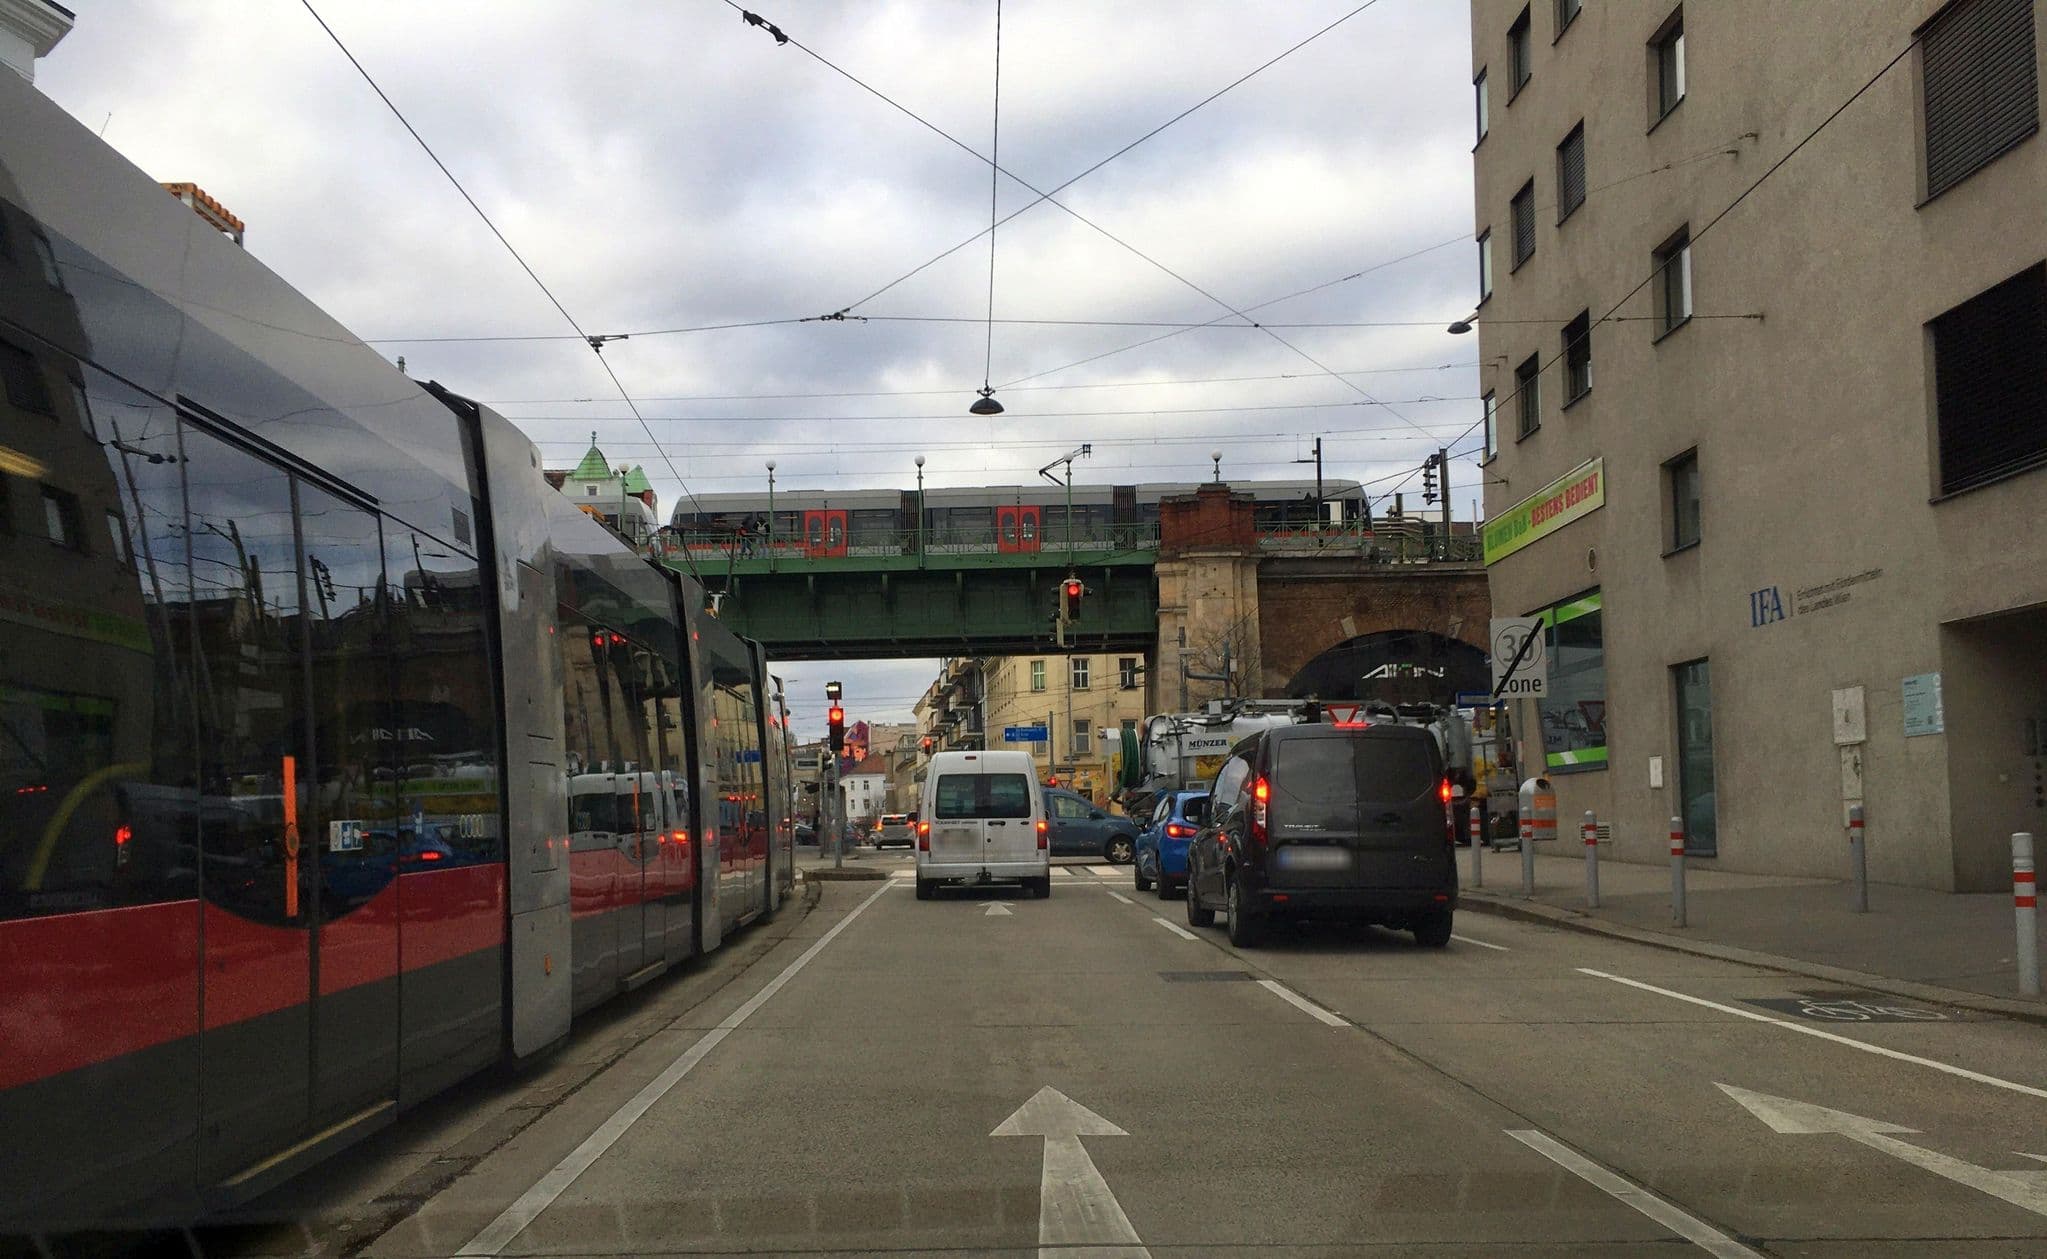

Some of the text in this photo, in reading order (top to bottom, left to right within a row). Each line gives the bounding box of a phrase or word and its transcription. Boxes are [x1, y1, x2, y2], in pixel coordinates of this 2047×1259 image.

[1532, 494, 1563, 527] BESTENS
[1565, 472, 1599, 510] BEDIENT
[1750, 586, 1785, 628] IFA
[1503, 634, 1534, 662] 30
[1499, 676, 1542, 693] Zone
[1188, 739, 1227, 748] MÜNZER
